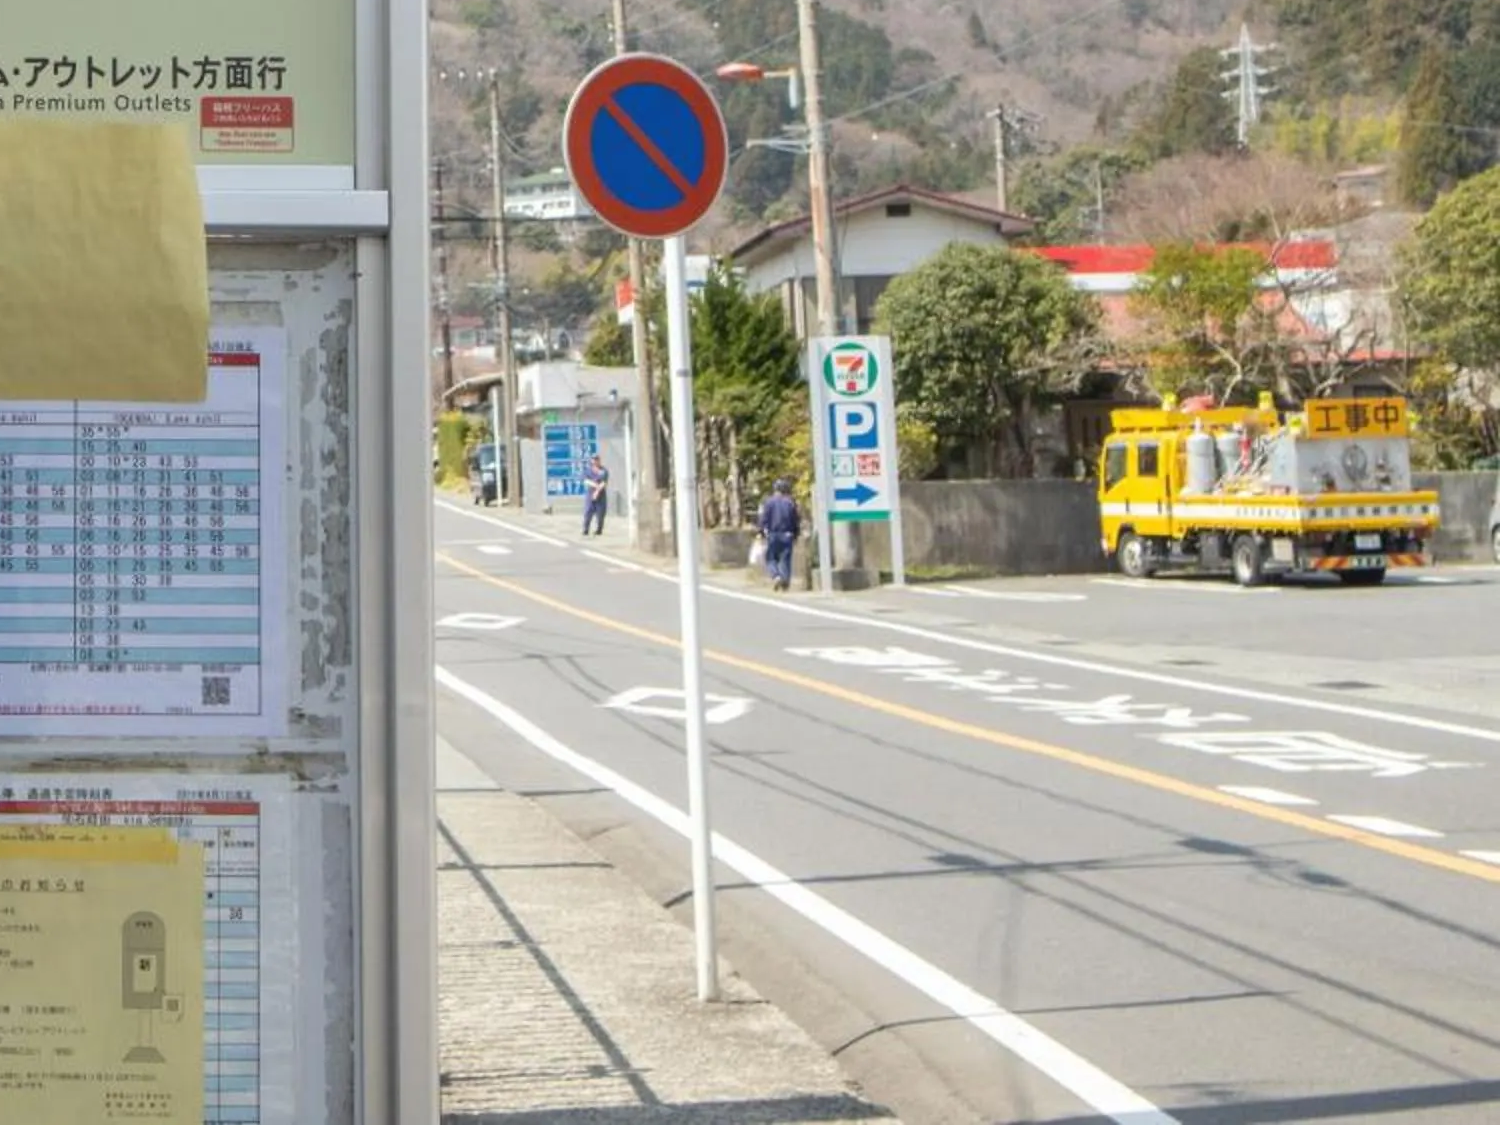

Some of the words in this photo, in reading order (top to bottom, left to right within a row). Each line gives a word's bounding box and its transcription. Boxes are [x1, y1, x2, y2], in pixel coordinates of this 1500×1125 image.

[13, 93, 106, 111] Premium
[114, 93, 192, 111] Outlets
[835, 404, 875, 449] P
[1315, 401, 1400, 433] 工事中
